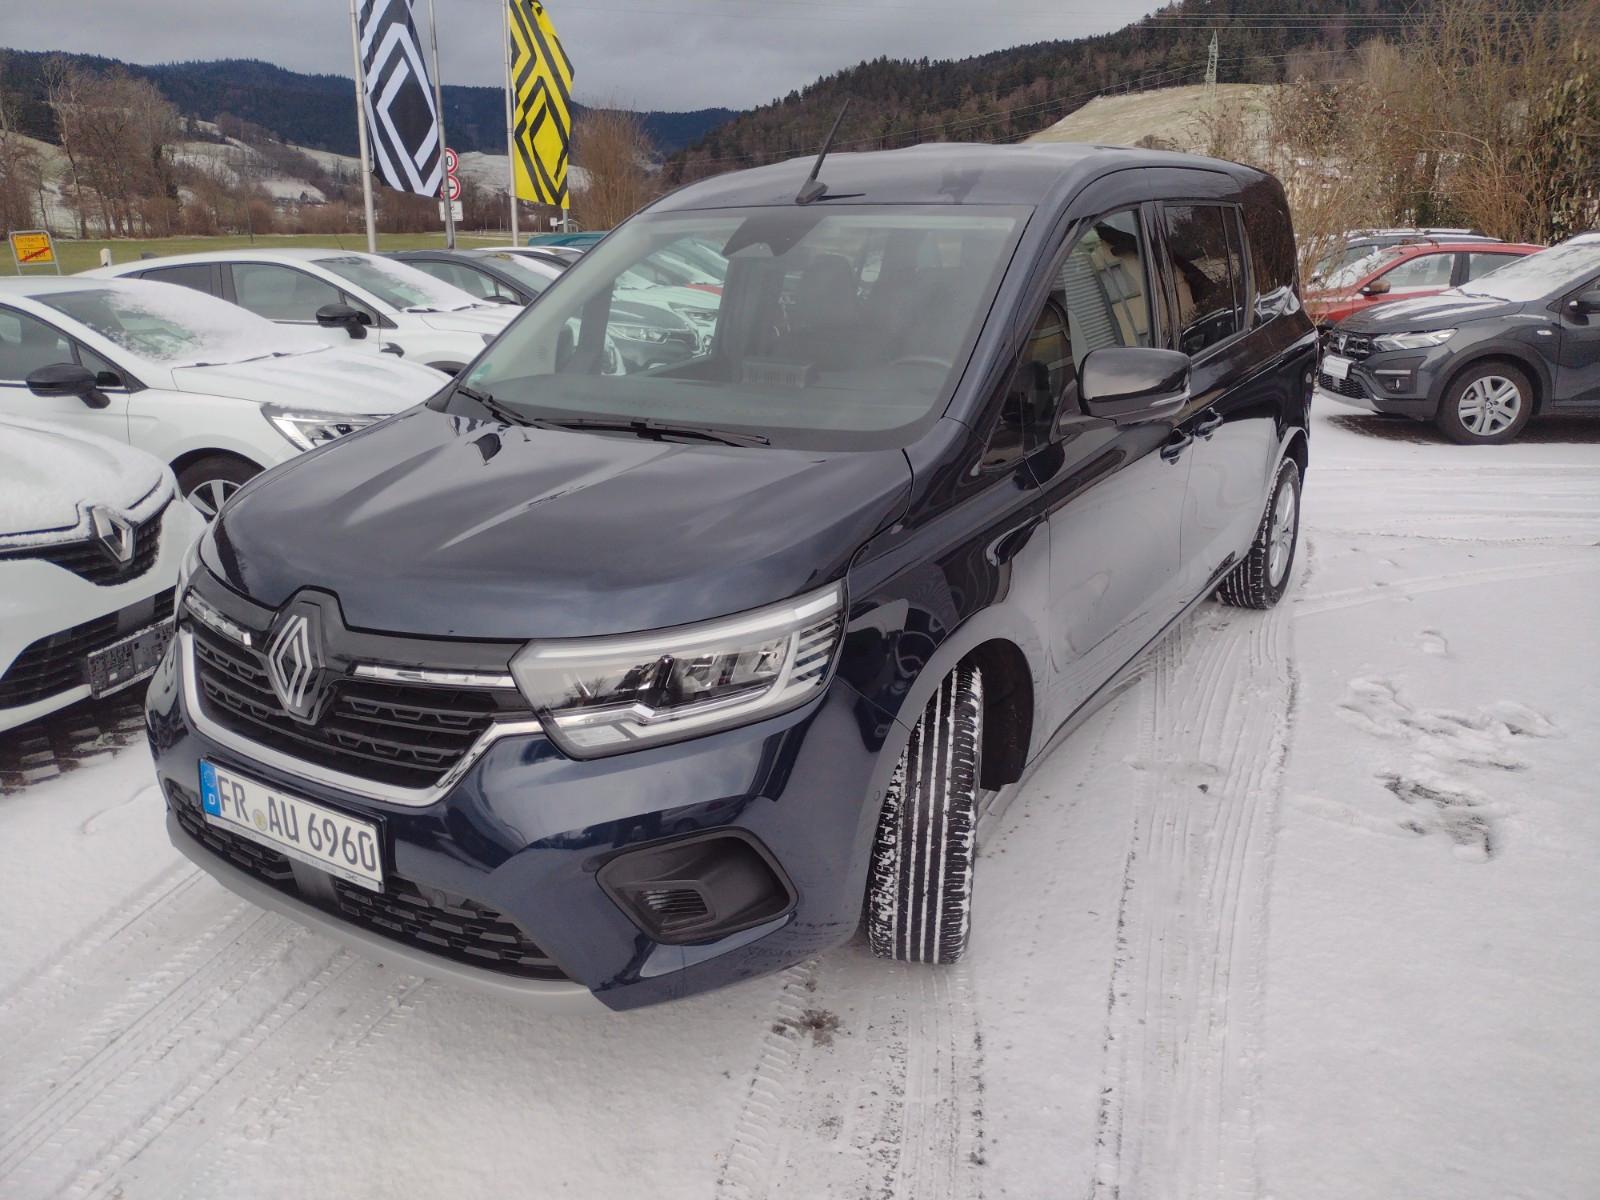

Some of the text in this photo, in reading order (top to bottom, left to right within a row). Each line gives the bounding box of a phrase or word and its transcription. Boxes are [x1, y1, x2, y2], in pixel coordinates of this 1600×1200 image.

[208, 793, 216, 806] D
[217, 775, 249, 822] FR
[268, 796, 300, 844] AU
[307, 813, 377, 872] 6960
